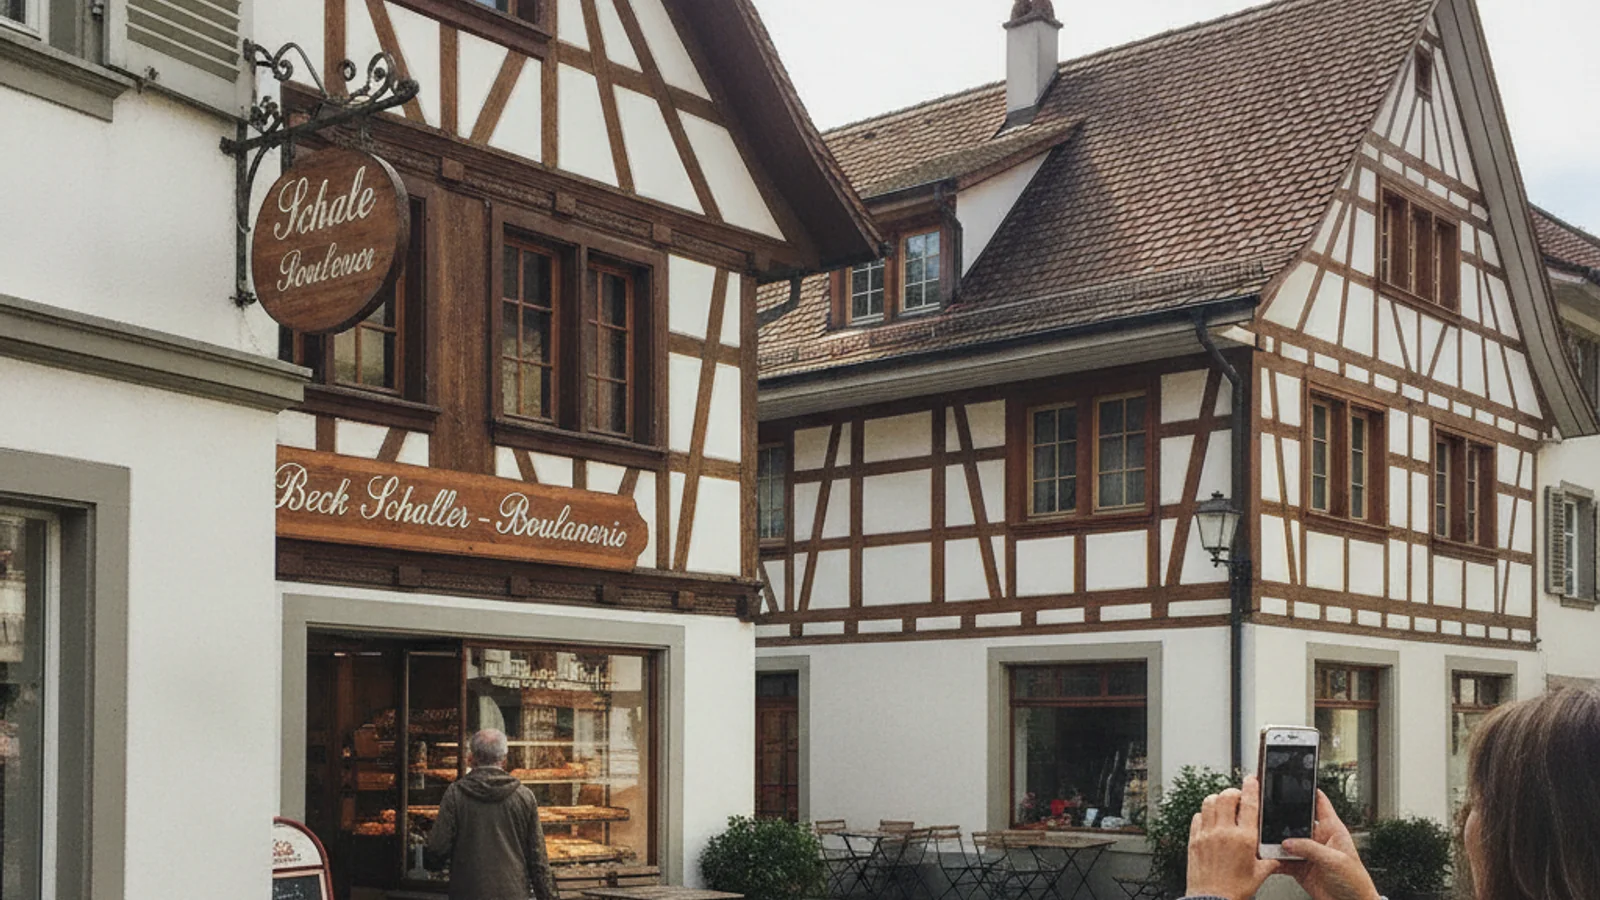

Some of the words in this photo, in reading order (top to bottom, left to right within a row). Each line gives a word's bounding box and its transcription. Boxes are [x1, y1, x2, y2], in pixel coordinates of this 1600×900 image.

[273, 165, 376, 240] Schale
[275, 462, 351, 516] Beck
[360, 475, 471, 528] Schaller
